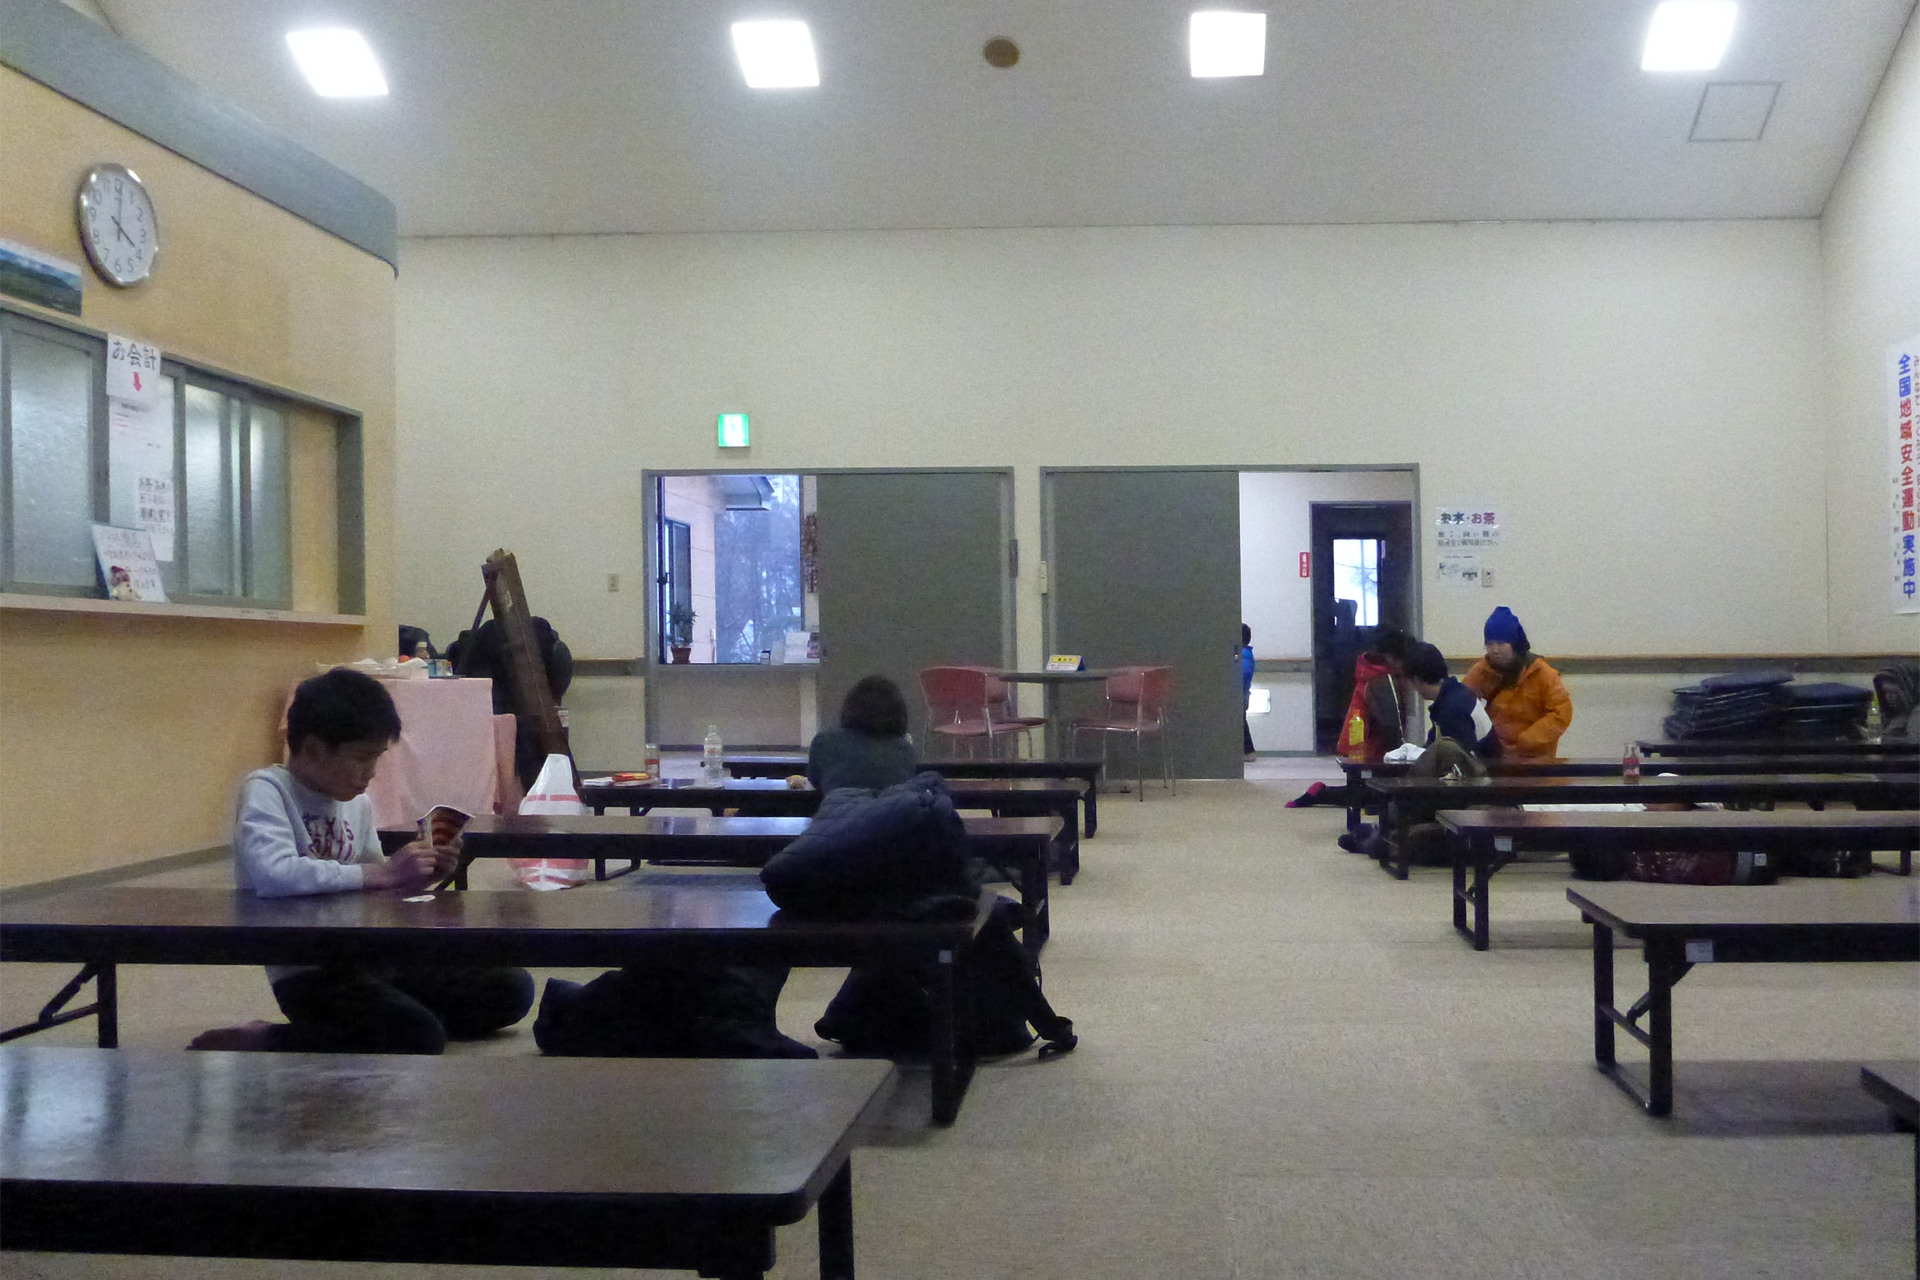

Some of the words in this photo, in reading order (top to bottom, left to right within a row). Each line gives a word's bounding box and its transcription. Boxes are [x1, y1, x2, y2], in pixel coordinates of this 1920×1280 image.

[90, 207, 97, 222] 9
[137, 207, 144, 222] 2
[93, 229, 100, 244] 8
[141, 228, 147, 244] 3
[104, 247, 110, 261] 7
[115, 259, 122, 273] 6
[127, 258, 134, 273] 5
[112, 341, 157, 371] お会計
[1441, 512, 1496, 525] お水・お茶
